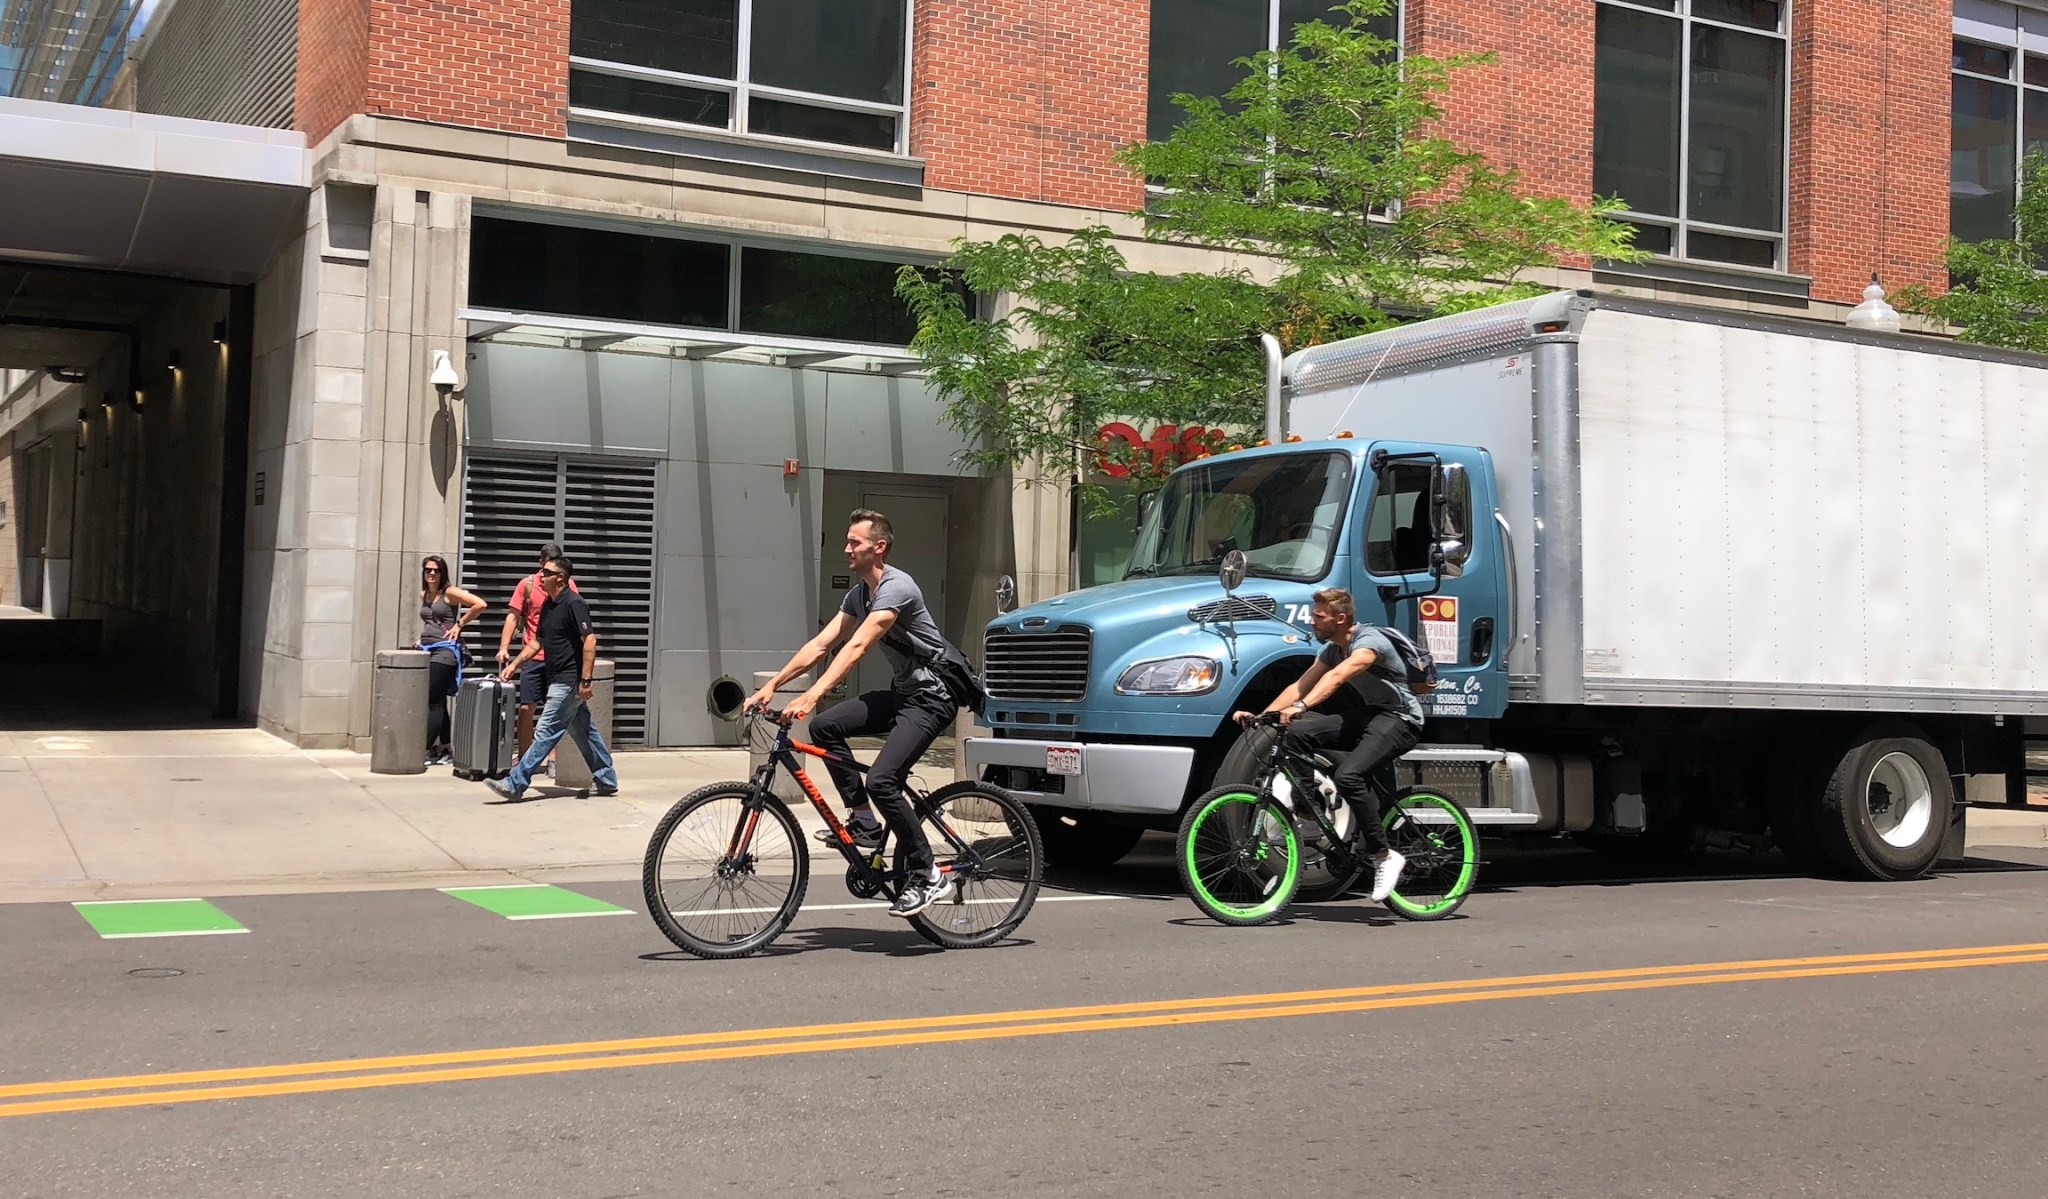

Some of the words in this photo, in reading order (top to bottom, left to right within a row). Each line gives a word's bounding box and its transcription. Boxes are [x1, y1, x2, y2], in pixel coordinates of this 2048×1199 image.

[1418, 623, 1457, 638] REPUBLIC
[1463, 675, 1483, 694] Co.
[793, 768, 855, 845] MONGOOSE
